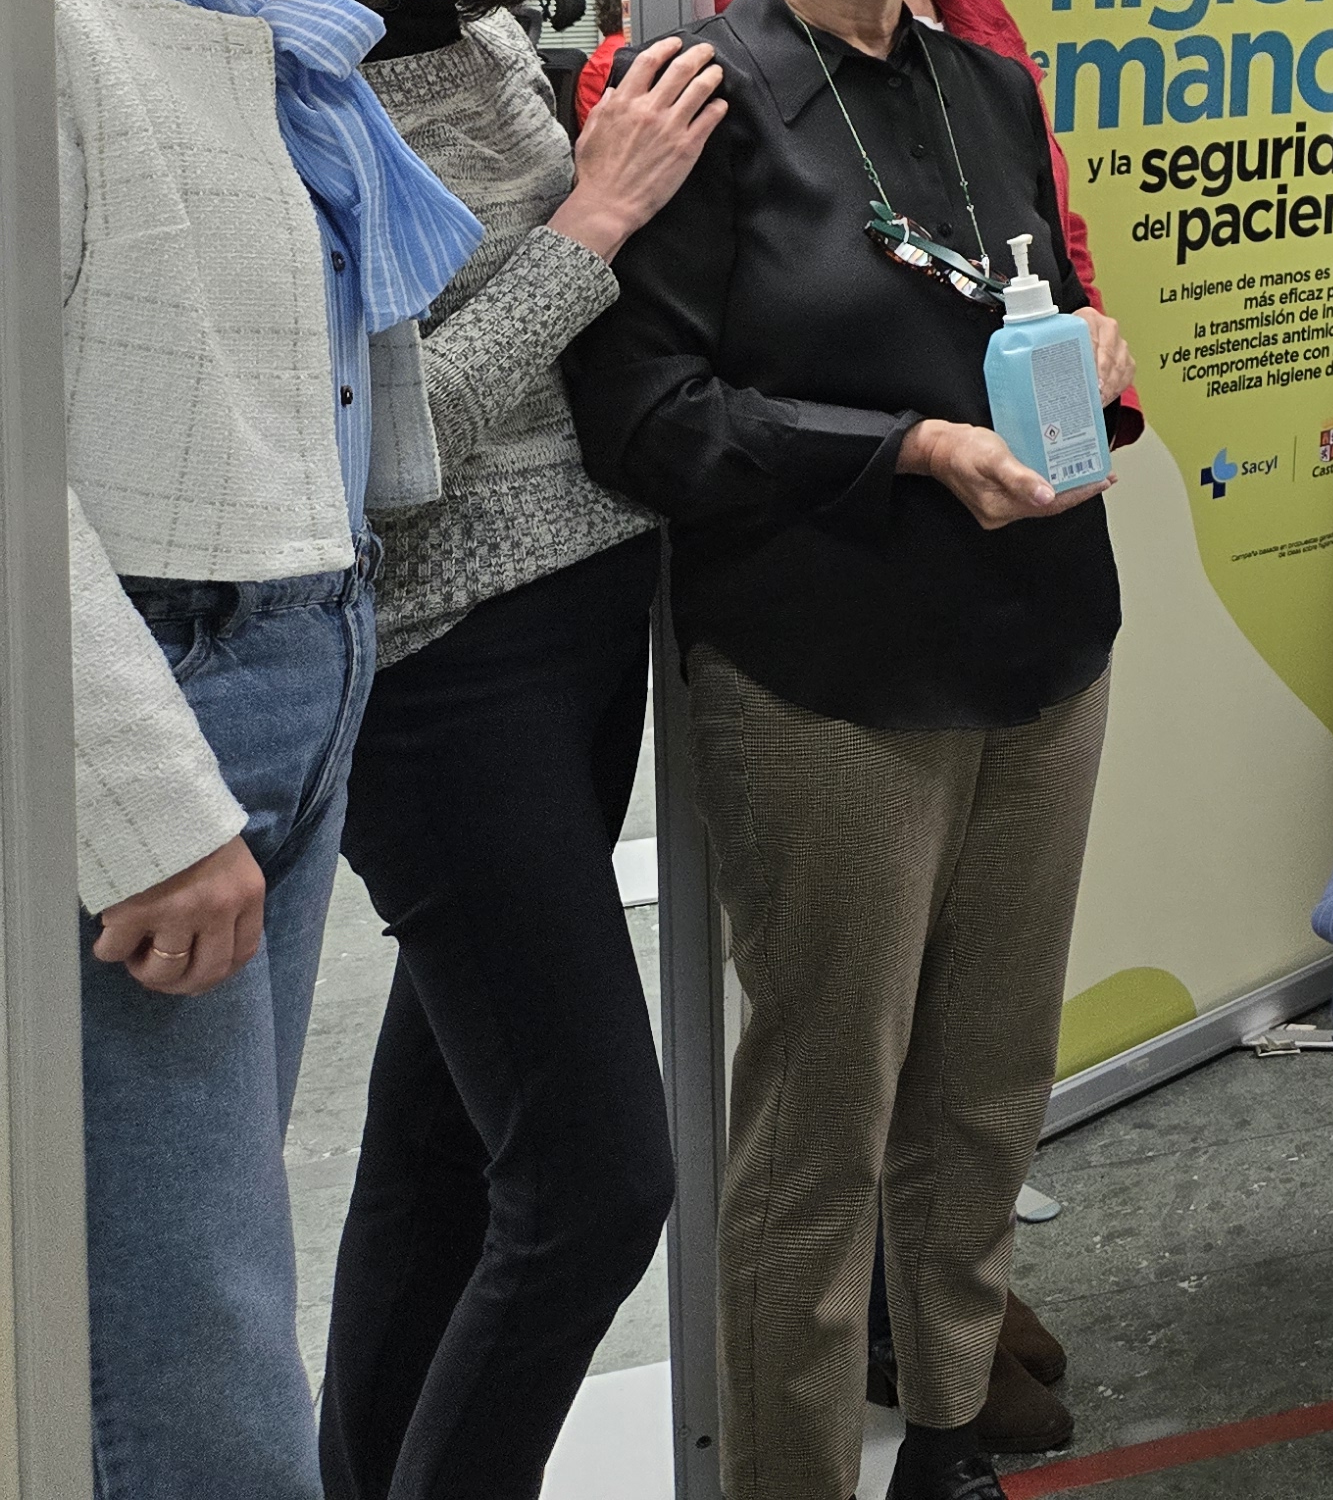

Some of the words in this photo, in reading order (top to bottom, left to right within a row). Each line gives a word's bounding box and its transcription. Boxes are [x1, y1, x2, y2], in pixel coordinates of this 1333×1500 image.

[1087, 156, 1104, 184] y
[1110, 149, 1132, 176] la
[1131, 211, 1172, 242] del
[1159, 287, 1177, 304] La
[1180, 279, 1233, 302] higiene
[1236, 273, 1256, 291] de
[1259, 268, 1311, 288] manos
[1314, 265, 1331, 281] es
[1243, 291, 1276, 310] más
[1278, 286, 1324, 306] eficaz
[1194, 322, 1206, 340] la
[1210, 309, 1296, 337] transmisión
[1299, 305, 1319, 322] de
[1159, 352, 1169, 370] y
[1172, 346, 1191, 365] de
[1194, 331, 1279, 360] resistencias
[1181, 349, 1300, 383] ¡Comprométete
[1303, 345, 1330, 363] con
[1206, 375, 1263, 398] ¡Realiza
[1266, 365, 1322, 387] higiene
[1240, 455, 1279, 476] Sacyl
